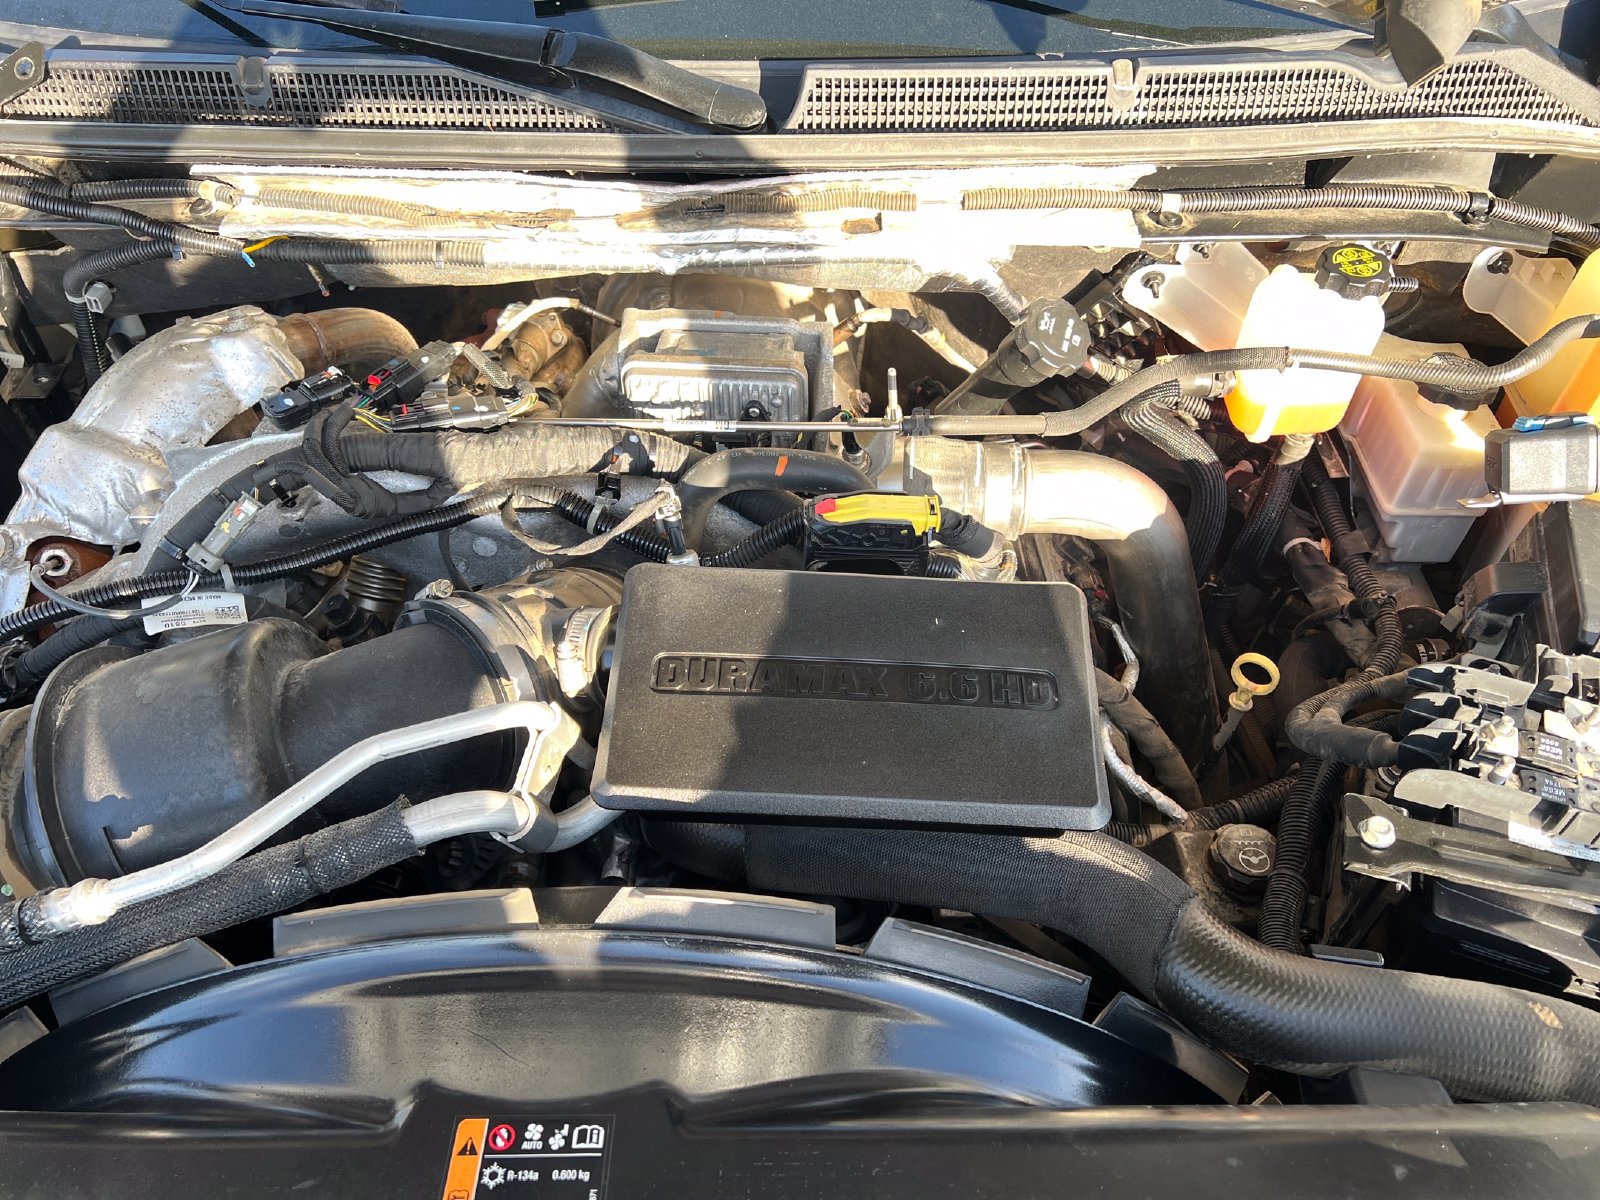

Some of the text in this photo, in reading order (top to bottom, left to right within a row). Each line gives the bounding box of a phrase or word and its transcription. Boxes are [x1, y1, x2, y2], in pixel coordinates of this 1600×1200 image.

[655, 658, 1053, 705] DURAMAX 6.6 HD
[521, 1140, 544, 1151] AUTO
[506, 1169, 591, 1183] R-134a 0.600 kg
